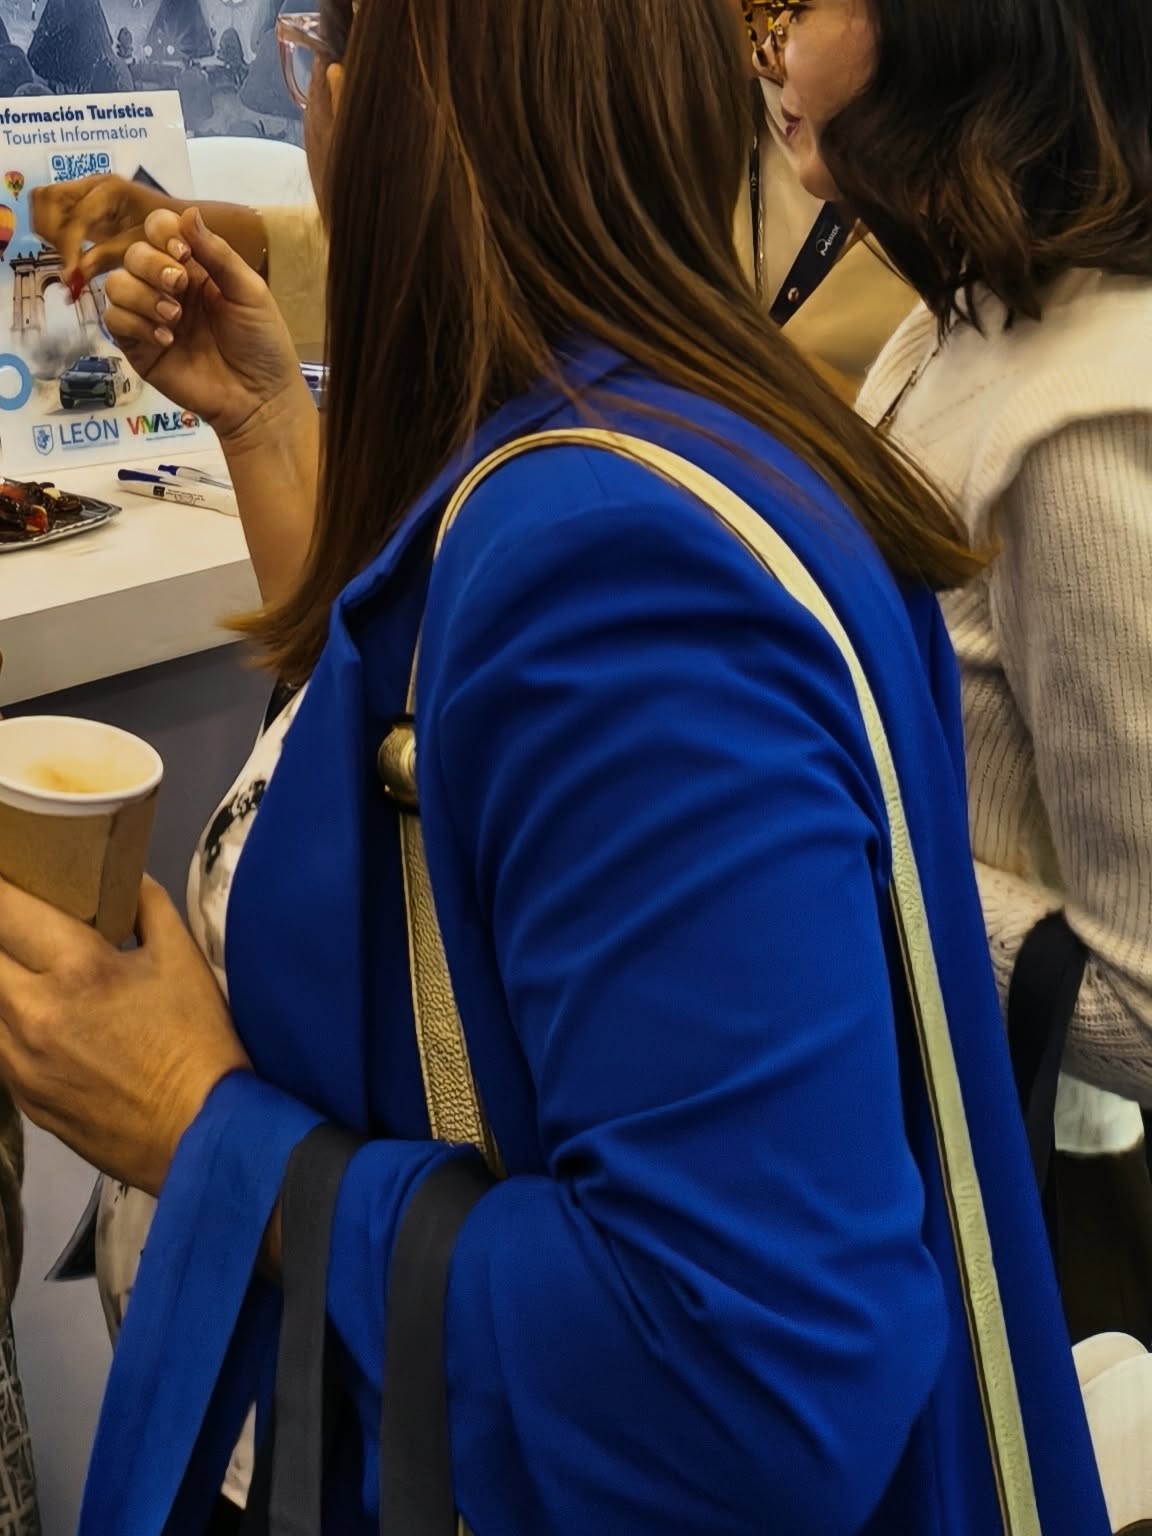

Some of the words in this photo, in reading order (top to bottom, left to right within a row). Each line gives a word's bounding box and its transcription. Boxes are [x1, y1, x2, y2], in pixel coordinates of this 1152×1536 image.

[86, 102, 154, 121] Turística
[3, 129, 57, 146] Tourist
[60, 124, 148, 143] Information
[59, 415, 120, 446] LEÓN
